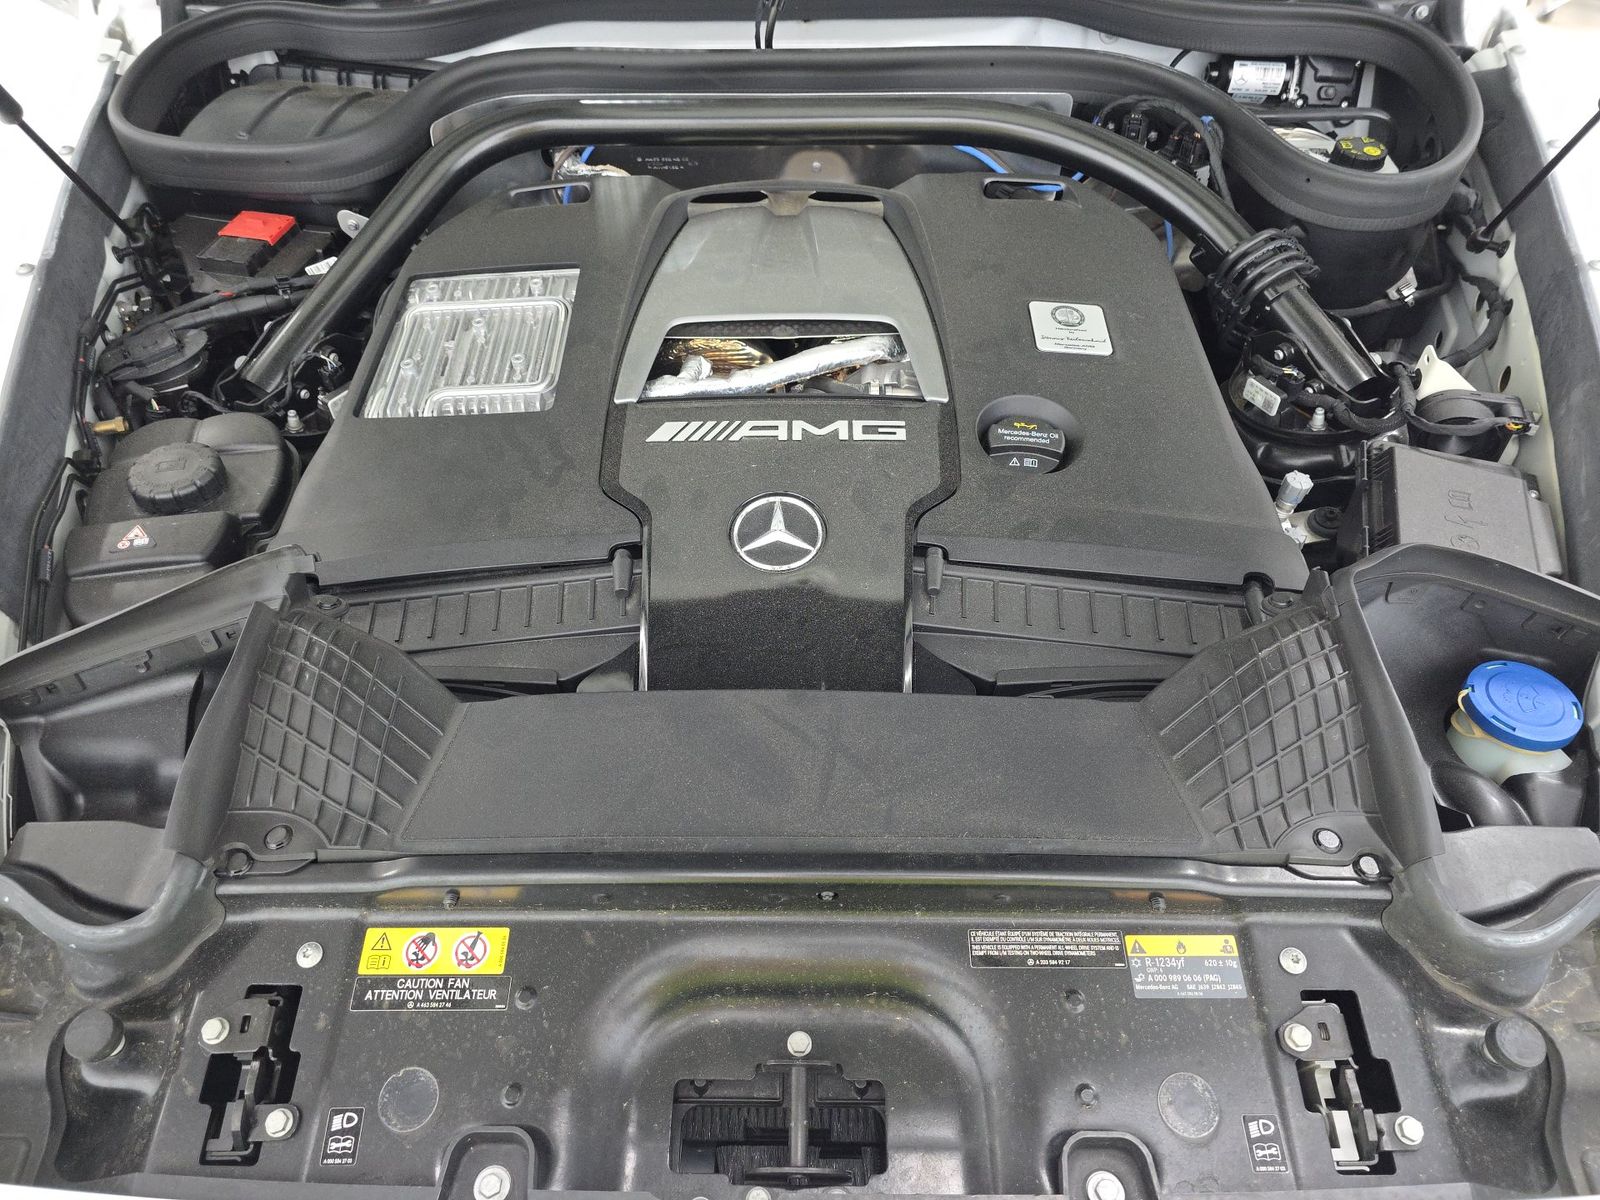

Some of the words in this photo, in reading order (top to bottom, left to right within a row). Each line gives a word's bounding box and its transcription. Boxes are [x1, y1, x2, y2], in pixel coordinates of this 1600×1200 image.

[728, 420, 906, 441] AMG
[997, 428, 1048, 438] Mercedes-Benz
[1003, 434, 1050, 444] recommended
[1145, 957, 1185, 969] R-1234yf
[1226, 960, 1238, 968] 10g
[1148, 974, 1153, 982] A
[1154, 974, 1167, 982] 000
[1184, 974, 1192, 982] 06
[1193, 974, 1201, 982] 06
[1203, 974, 1221, 983] (PAG)
[397, 979, 443, 989] CAUTION
[448, 979, 470, 989] FAN
[365, 990, 423, 1000] ATTENTION
[429, 990, 497, 1000] VENTILATEUR
